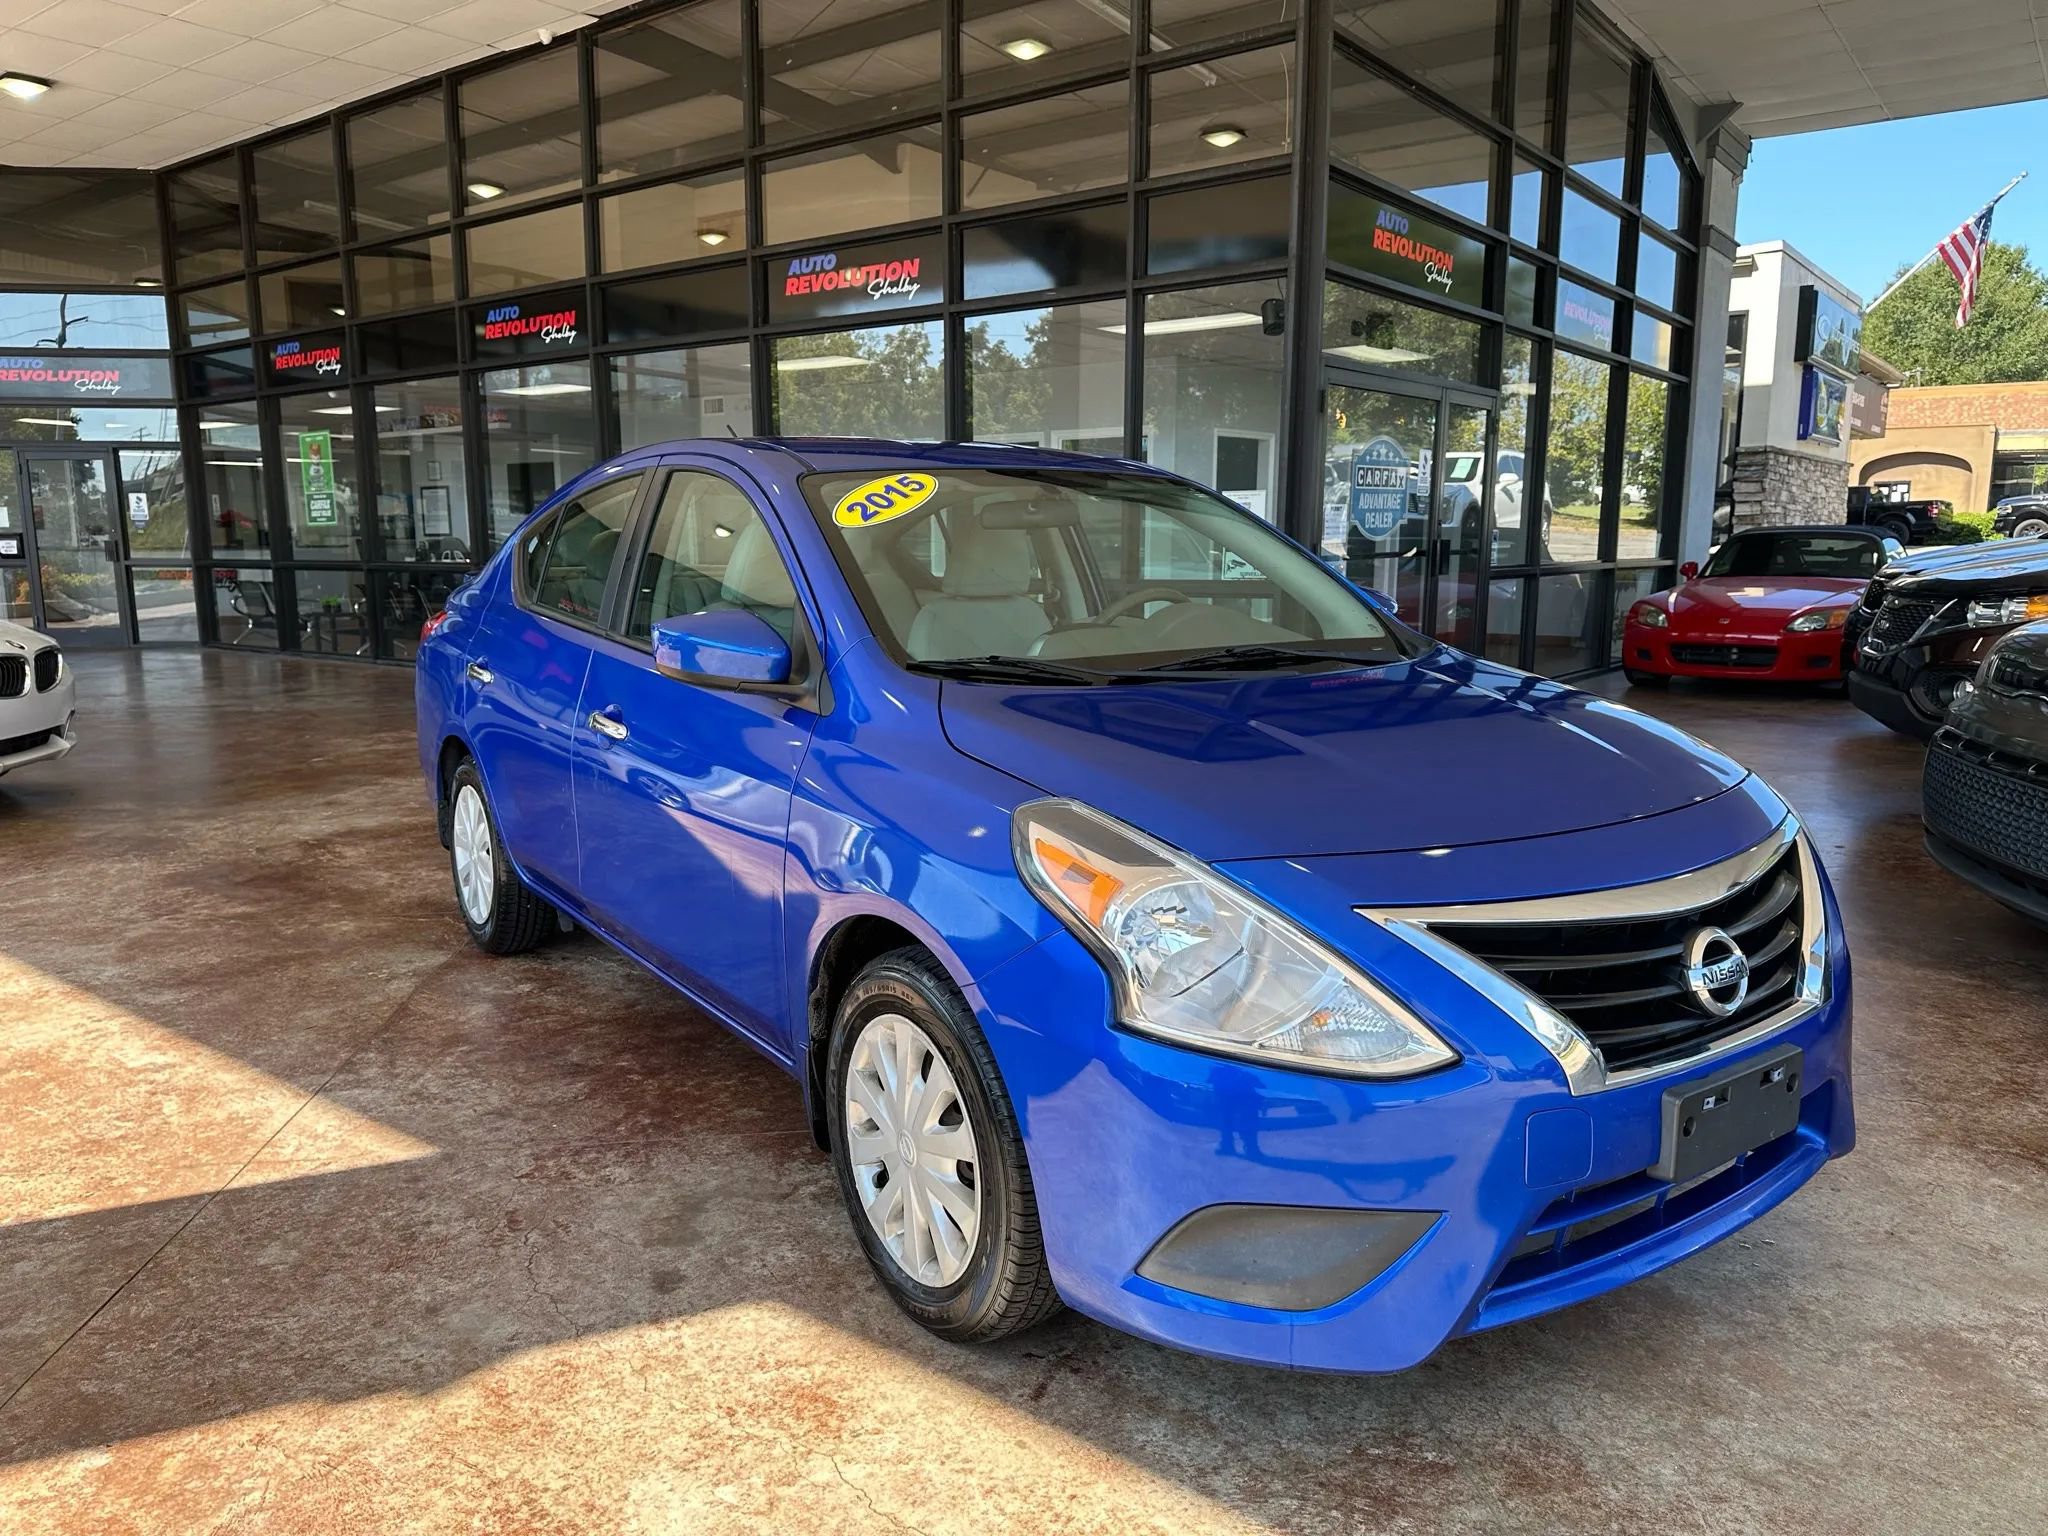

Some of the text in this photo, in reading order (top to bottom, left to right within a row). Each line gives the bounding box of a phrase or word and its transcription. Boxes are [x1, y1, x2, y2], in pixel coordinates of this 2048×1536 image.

[1376, 210, 1409, 234] AUTO
[1373, 228, 1454, 272] REVOLUTION
[788, 253, 837, 276] AUTO
[785, 258, 920, 296] REVOLUTION
[867, 273, 921, 300] Shelby
[1424, 261, 1453, 293] Shelby
[485, 310, 576, 339] REVOLUTION
[486, 305, 519, 323] AUTO
[541, 322, 577, 344] Shelby
[275, 347, 340, 370] REVOLUTION
[276, 342, 300, 355] AUTO
[315, 356, 342, 376] Shelby
[74, 378, 122, 395] Shelby
[1356, 467, 1406, 489] CARFAX
[847, 475, 925, 522] 2015
[1358, 493, 1401, 510] ADVANTAGE
[1365, 512, 1393, 529] DEALER
[1701, 958, 1749, 986] NISSAN
